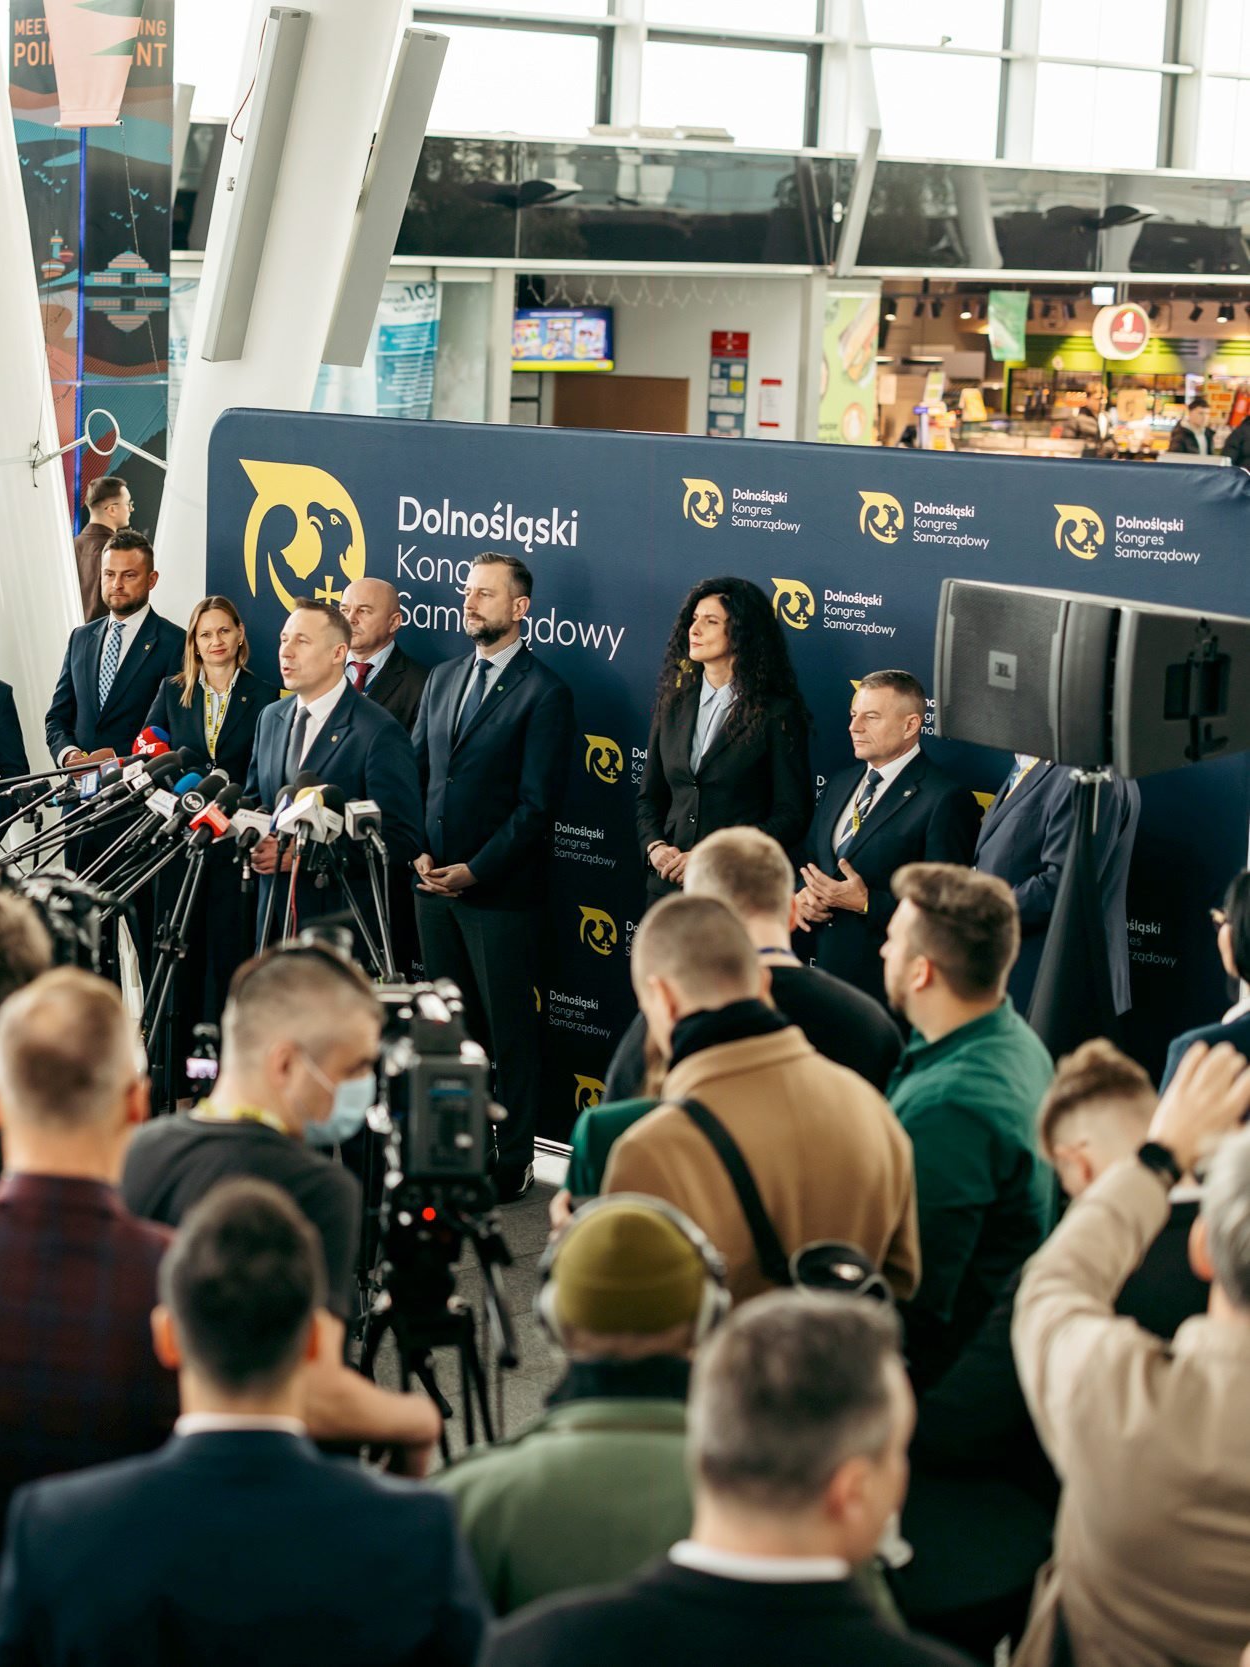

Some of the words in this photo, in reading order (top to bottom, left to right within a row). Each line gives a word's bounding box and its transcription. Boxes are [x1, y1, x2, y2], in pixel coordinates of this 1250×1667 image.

[14, 18, 49, 36] MEET
[13, 41, 54, 67] POI
[732, 488, 788, 505] Dolnośląski
[732, 502, 772, 517] Kongres
[914, 501, 975, 519] Dolnośląski
[398, 496, 579, 553] Dolnośląski
[731, 515, 801, 534] Samorządowy
[913, 516, 958, 532] Kongres
[1116, 515, 1184, 534] Dolnośląski
[912, 530, 990, 550] Samorządowy
[1115, 530, 1165, 547] Kongres
[1114, 545, 1201, 565] Samorządowy
[396, 543, 474, 594] Kong
[824, 589, 883, 607] Dolnośląski
[823, 603, 866, 620] Kongres
[398, 591, 626, 661] Samądowy
[823, 617, 897, 638] Samorządowy
[554, 821, 605, 840] Dolnośląski
[554, 834, 591, 850] Kongres
[554, 846, 617, 869] Samorządowy
[1126, 918, 1161, 935] śląski
[1128, 950, 1177, 968] ządowy
[549, 990, 599, 1010] Dolnośląski
[549, 1003, 585, 1019] Kongres
[548, 1014, 611, 1039] Samorządowy
